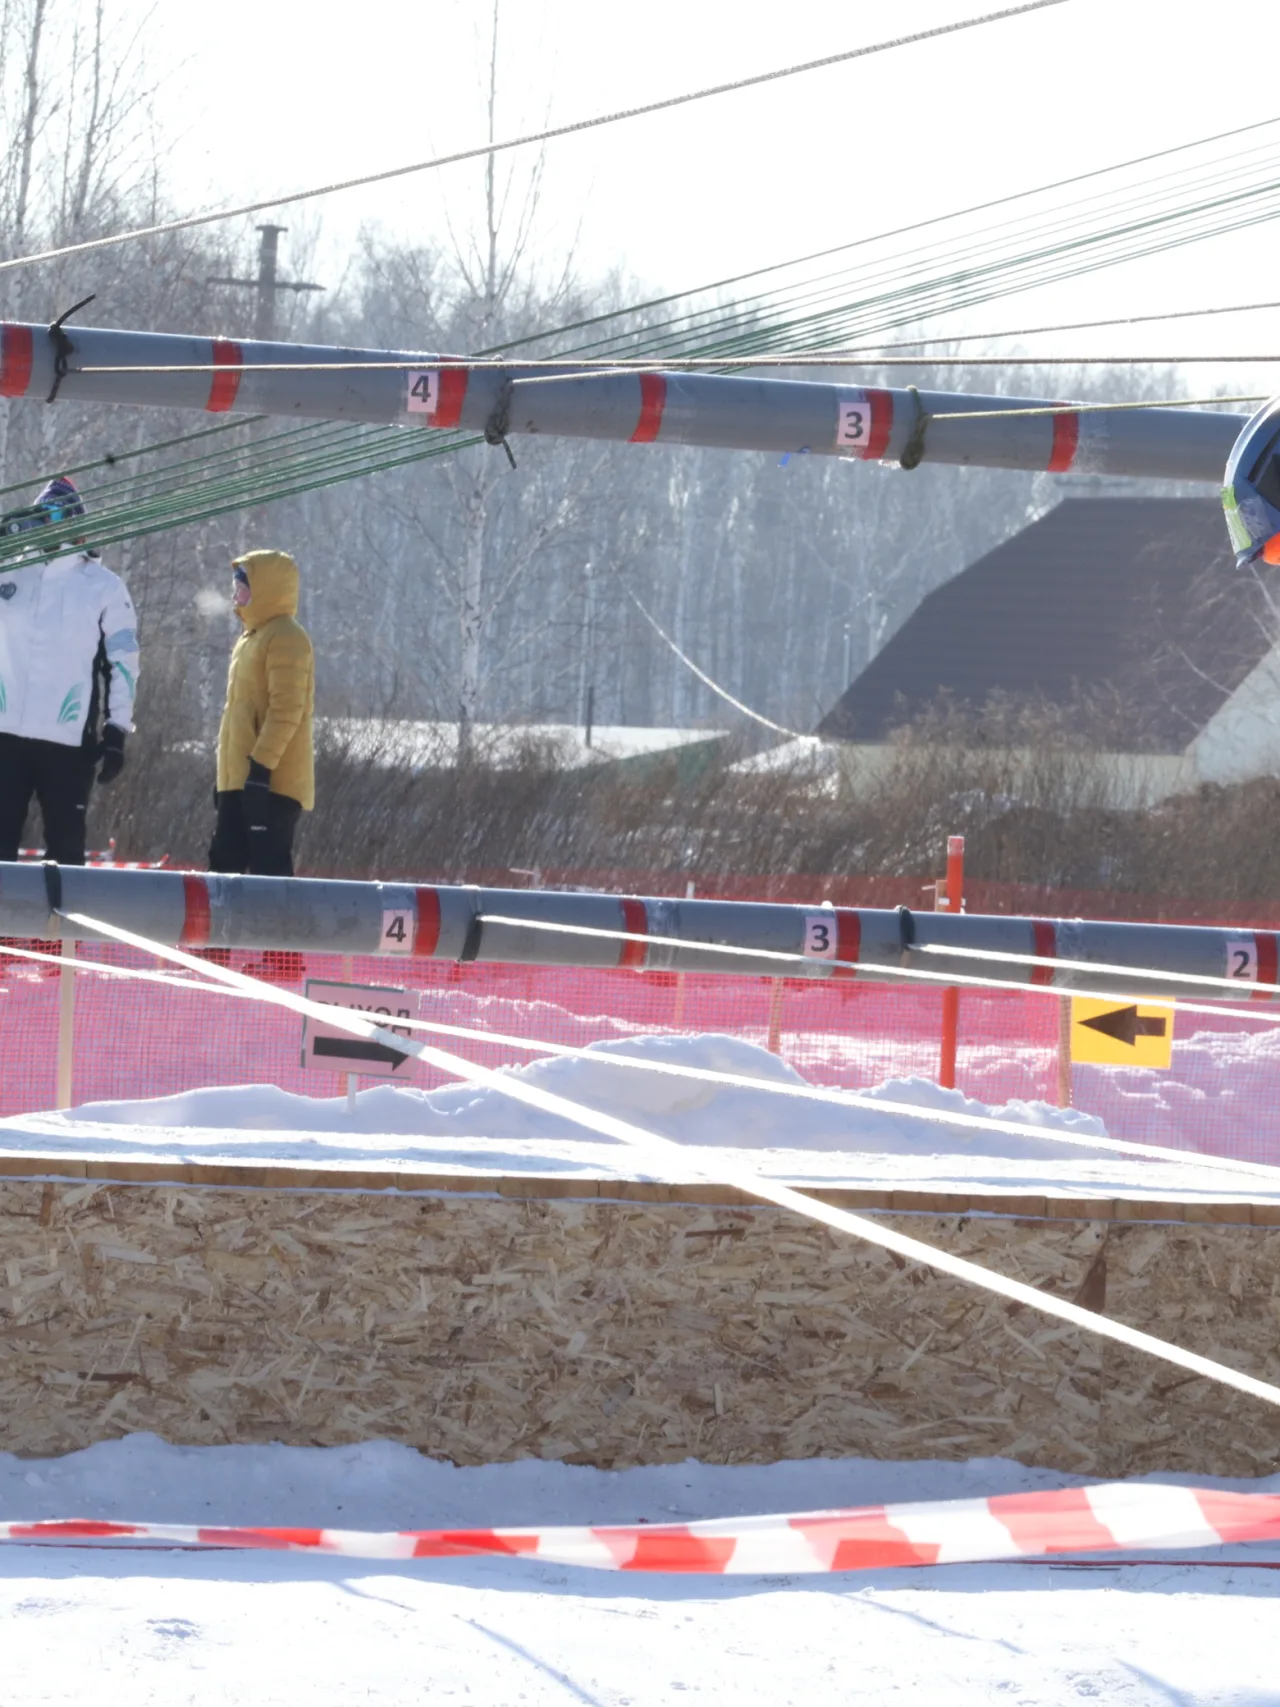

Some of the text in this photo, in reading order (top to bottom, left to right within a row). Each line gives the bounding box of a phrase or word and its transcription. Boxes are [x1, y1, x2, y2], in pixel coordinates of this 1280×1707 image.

[411, 375, 431, 403] 4
[845, 411, 863, 439] 3
[386, 916, 406, 942] 4
[811, 924, 829, 952] 3
[1233, 950, 1250, 977] 2
